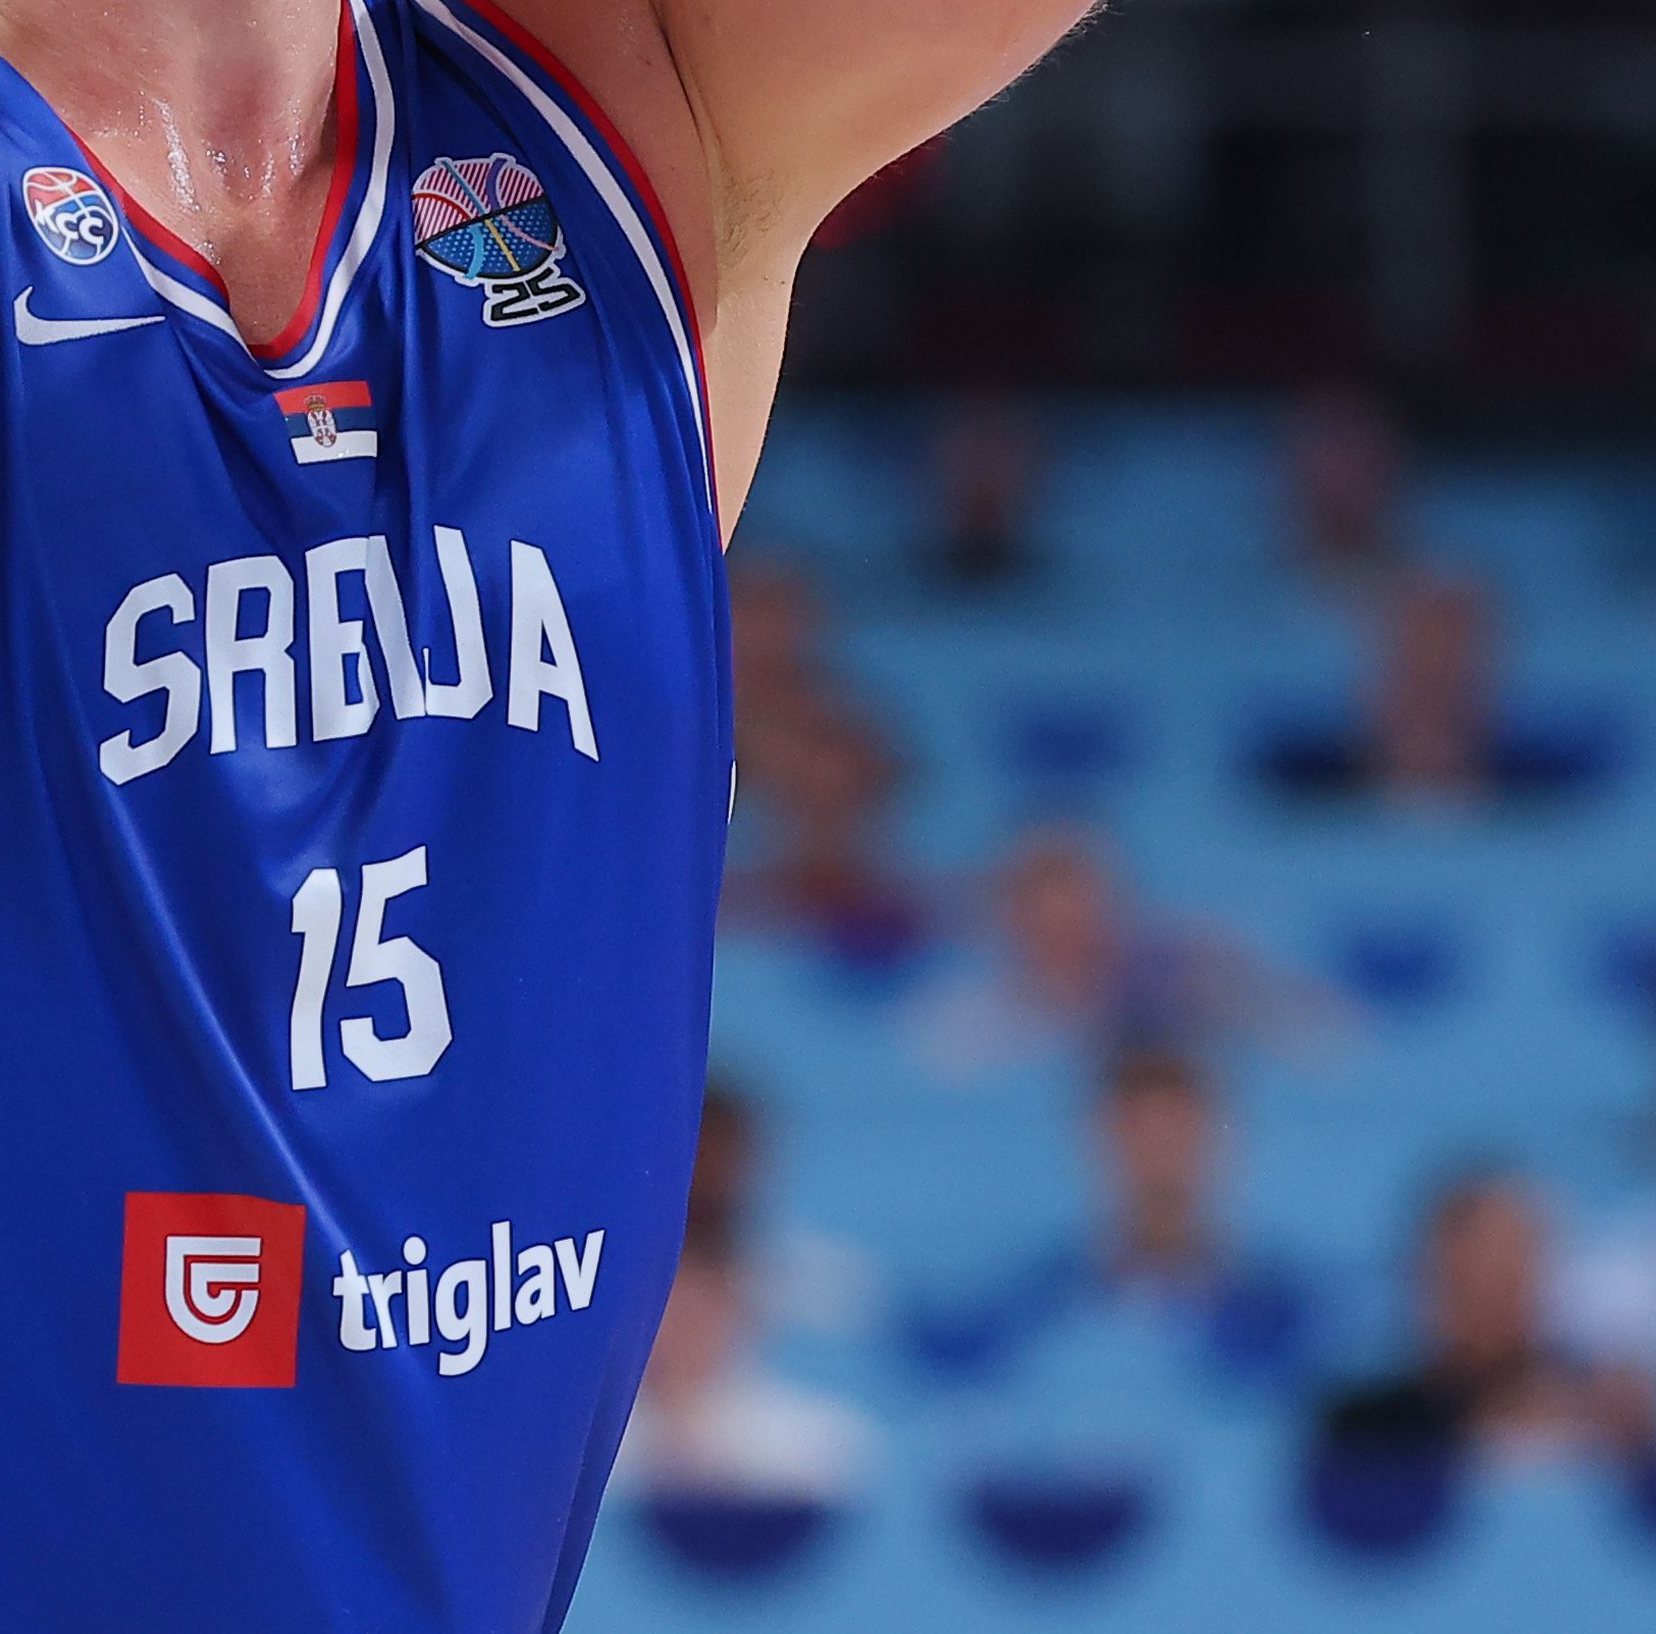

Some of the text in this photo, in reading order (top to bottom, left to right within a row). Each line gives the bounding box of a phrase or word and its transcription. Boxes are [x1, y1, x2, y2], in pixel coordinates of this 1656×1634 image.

[99, 524, 600, 786] SRBIJA
[290, 845, 453, 1090] 15
[332, 1219, 606, 1378] triglav
